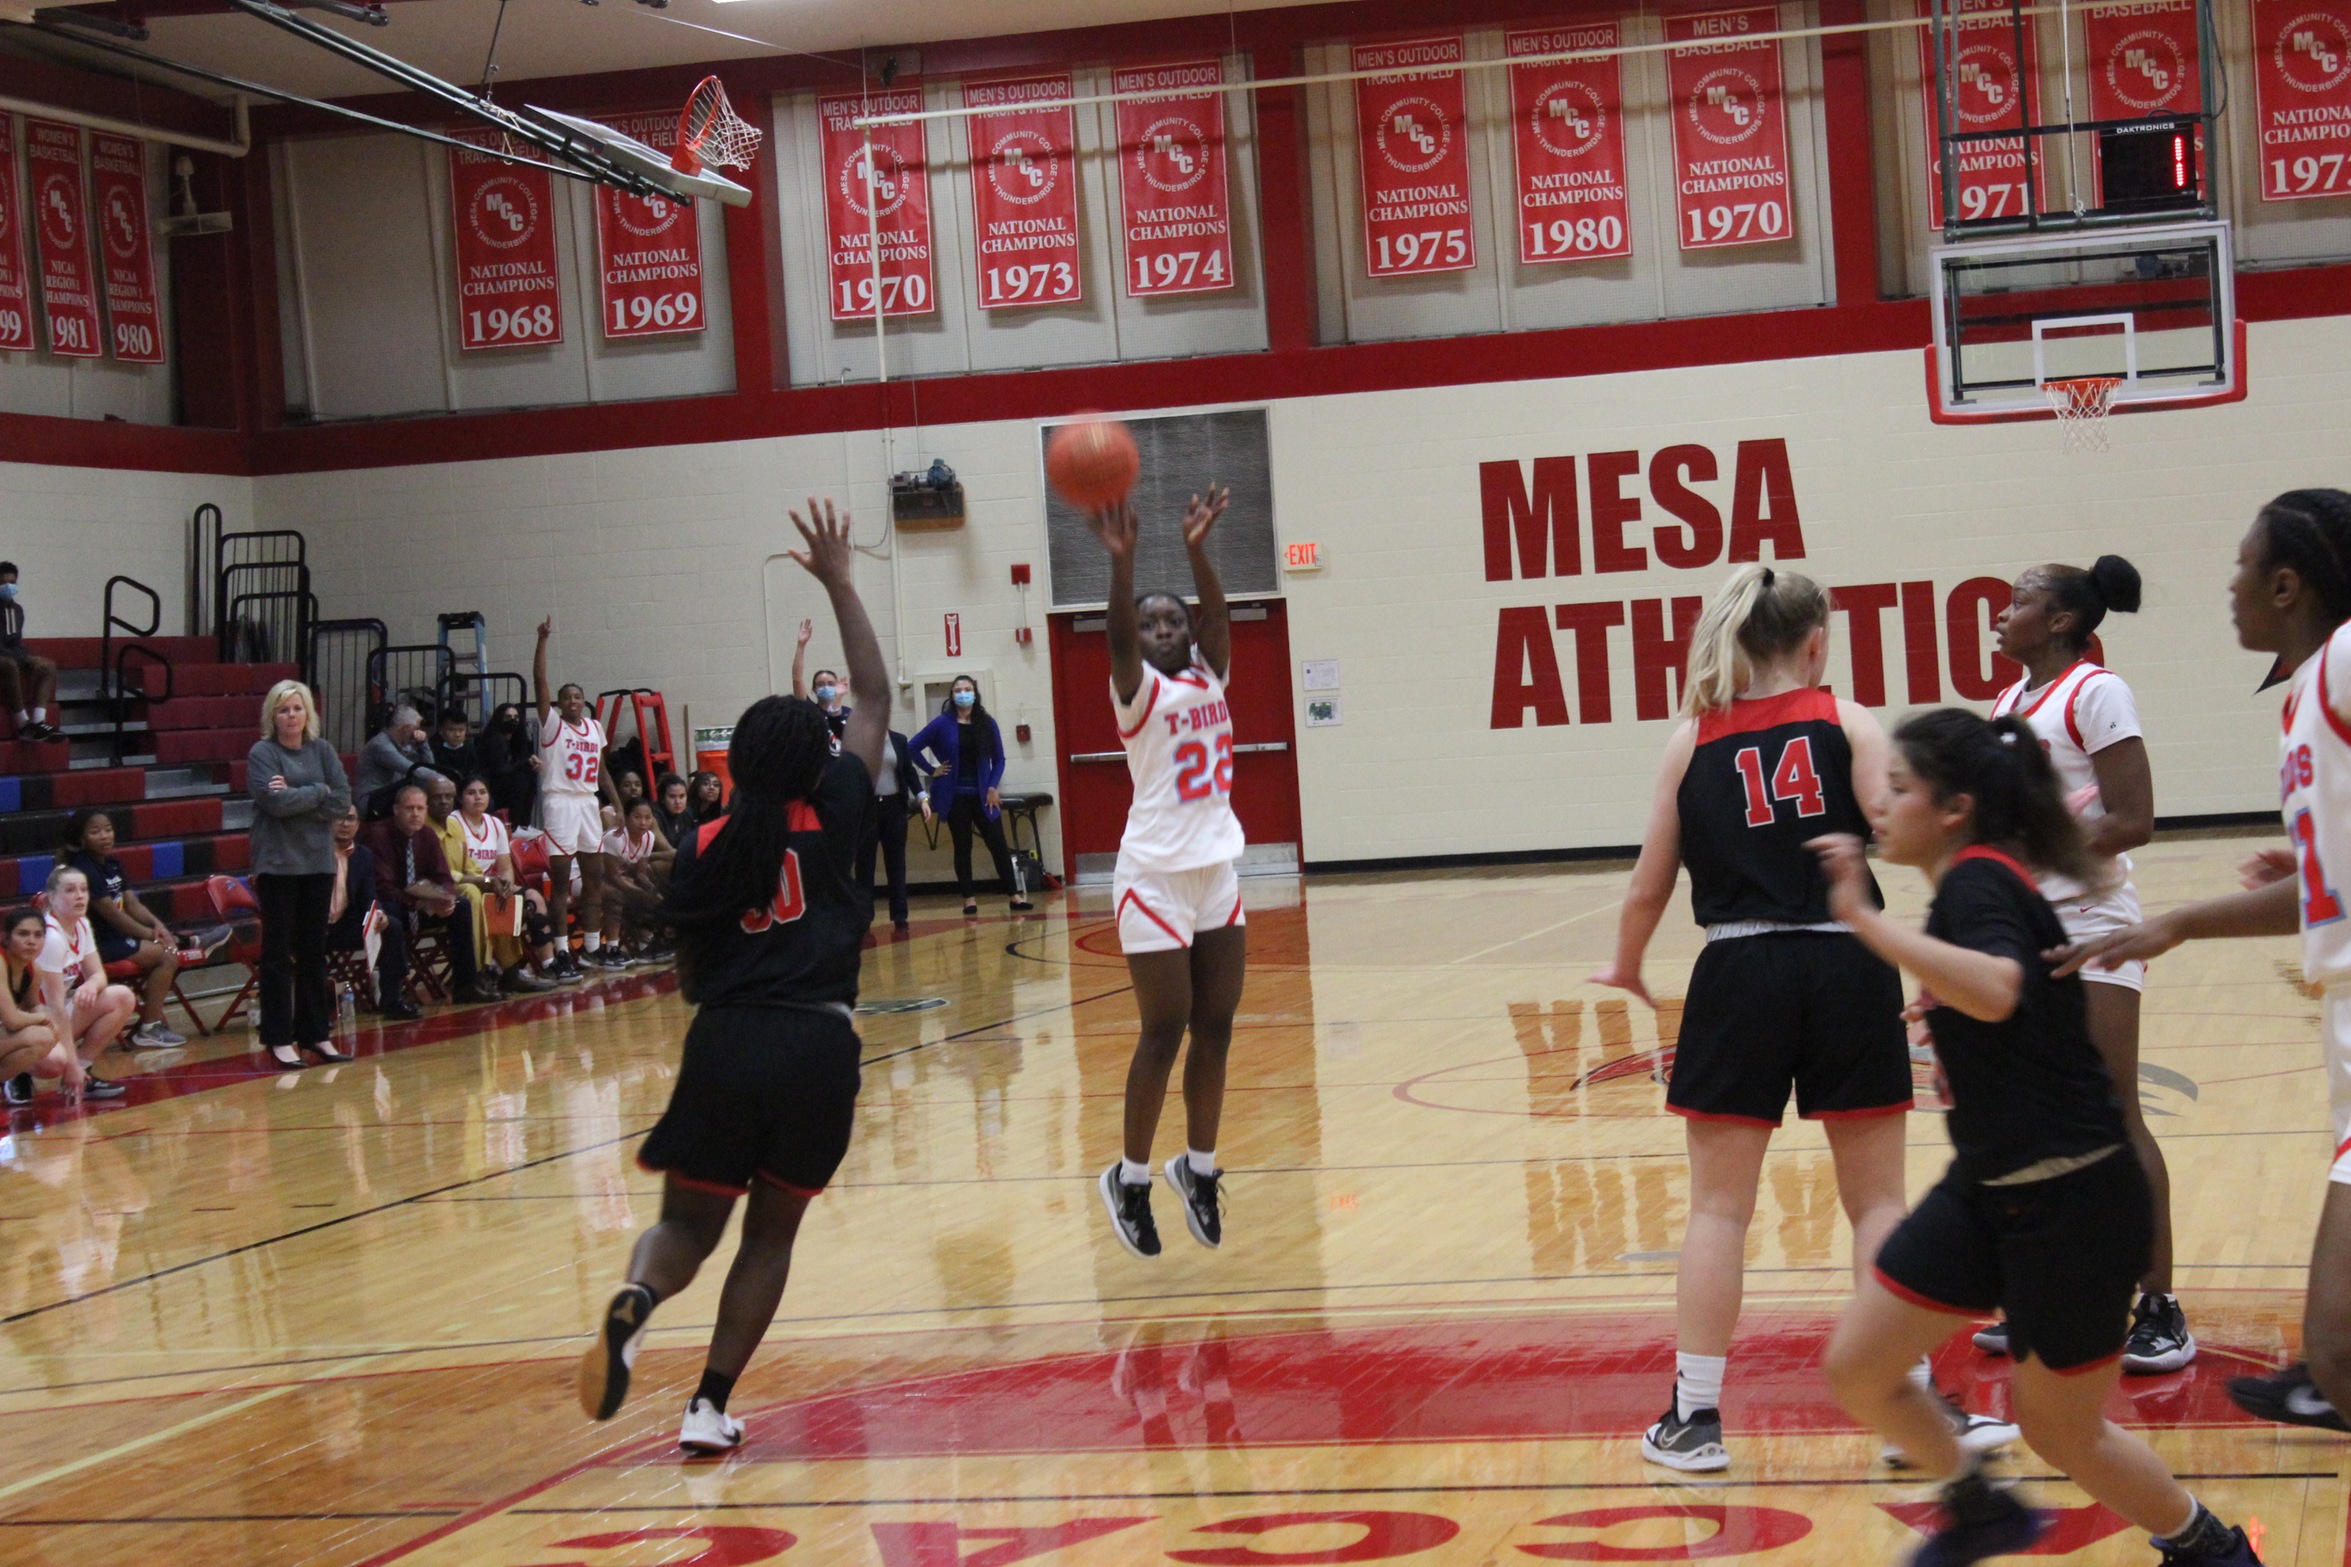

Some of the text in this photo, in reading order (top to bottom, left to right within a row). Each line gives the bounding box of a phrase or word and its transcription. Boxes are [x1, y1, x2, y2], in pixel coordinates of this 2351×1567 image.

[2093, 0, 2192, 19] BASEBALL
[1693, 15, 1749, 36] MEN'S
[2279, 13, 2334, 40] COMMUNITY
[1512, 29, 1615, 54] MEN'S OUTDOOR
[1675, 40, 1771, 58] BASEBALL
[2293, 31, 2338, 73] MCC
[1357, 43, 1459, 68] MEN'S OUTDOOR
[2107, 30, 2185, 86] MESA COMMUNITY COLLEGE
[2274, 41, 2285, 69] MESA
[1119, 67, 1217, 90] MEN'S OUTDOOR
[1998, 51, 2020, 93] COLLEGE
[2125, 48, 2169, 90] MCC
[2282, 67, 2351, 93] THUNDERBIRDS
[969, 81, 1066, 103] MEN'S OUTDOOR
[1689, 68, 1766, 122] MESA COMMUNITY COLLEGE
[1960, 63, 2004, 104] MCC
[2114, 83, 2182, 110] THUNDERBIRDS
[823, 95, 918, 116] MEN'S OUTDOOR
[1531, 81, 1606, 134] MESA COMMUNITY COLLEGE
[1549, 98, 1590, 139] MCC
[1706, 85, 1750, 126] MCC
[2272, 105, 2351, 126] NATIONA
[603, 115, 680, 134] EN'S OUTDOO
[829, 115, 868, 132] TRAC
[1377, 97, 1451, 150] MESA COMMUNITY COLLEGE
[1394, 114, 1436, 154] MCC
[1697, 119, 1762, 145] THUNDERBIRDS
[2116, 122, 2175, 134] DAKTRONICS
[2264, 123, 2351, 145] CHAMPIO
[652, 131, 680, 147] FIEL
[1137, 117, 1210, 170] MESA COMMUNITY COLLEGE
[1538, 132, 1603, 158] THUNDERBIRDS
[988, 131, 1059, 183] MESA COMMUNITY COLLEGE
[1153, 134, 1194, 174] MCC
[1384, 148, 1448, 173] THUNDERBIRDS
[1689, 155, 1775, 177] NATIONAL
[1933, 151, 2039, 175] CAMPIONS
[841, 144, 910, 195] MESA COMMNITY COLLEGE
[1004, 148, 1043, 187] MCC
[1145, 168, 1207, 193] THUNDERBIRDS
[1530, 169, 1615, 190] NATIONAL
[2270, 154, 2351, 194] 197
[994, 182, 1055, 205] THUNDERBIRDS
[1376, 184, 1460, 205] NATIONAL
[1682, 171, 1785, 195] CHAMPIONS
[470, 177, 538, 227] MESA COMMUNITY COLLEGE
[847, 194, 907, 218] THUNERBIRDS
[1523, 185, 1624, 208] CHAMPIONS
[1962, 182, 2029, 221] 971
[486, 193, 524, 231] MCC
[1136, 204, 1218, 224] NATIONAL
[1369, 200, 1469, 222] CHAMPIONS
[1687, 201, 1783, 242] 1970
[477, 227, 535, 248] THUNDERBIRDS
[620, 213, 678, 237] THUNDERBIRDS
[988, 217, 1067, 237] NATIONAL
[1129, 220, 1226, 242] CHAMPIONS
[1529, 215, 1623, 256] 1980
[839, 229, 918, 248] NATONAL
[981, 233, 1076, 254] CHAMPIONS
[1375, 229, 1467, 269] 1975
[470, 261, 546, 280] NATIONAL
[613, 248, 690, 267] NATIONAL
[1134, 249, 1225, 289] 1974
[46, 275, 75, 289] REGION
[464, 276, 555, 296] CHAMPIONS
[606, 263, 698, 284] CHAMPIONS
[987, 262, 1074, 300] 1973
[46, 291, 90, 307] HAMPIONS
[109, 283, 138, 297] REGION
[838, 274, 926, 312] 1970
[110, 298, 153, 315] HAMPIONS
[612, 292, 698, 330] 1969
[0, 310, 22, 341] 99
[50, 316, 90, 349] 1981
[469, 305, 554, 342] 1968
[117, 323, 153, 355] 980
[1479, 437, 1806, 582] MESA
[1289, 543, 1317, 566] EXIT
[1490, 576, 2104, 729] ATHTIC
[1165, 701, 1232, 736] T-BIRD
[566, 753, 599, 783] 32
[1174, 731, 1233, 804] 22
[1734, 736, 1826, 828] 14
